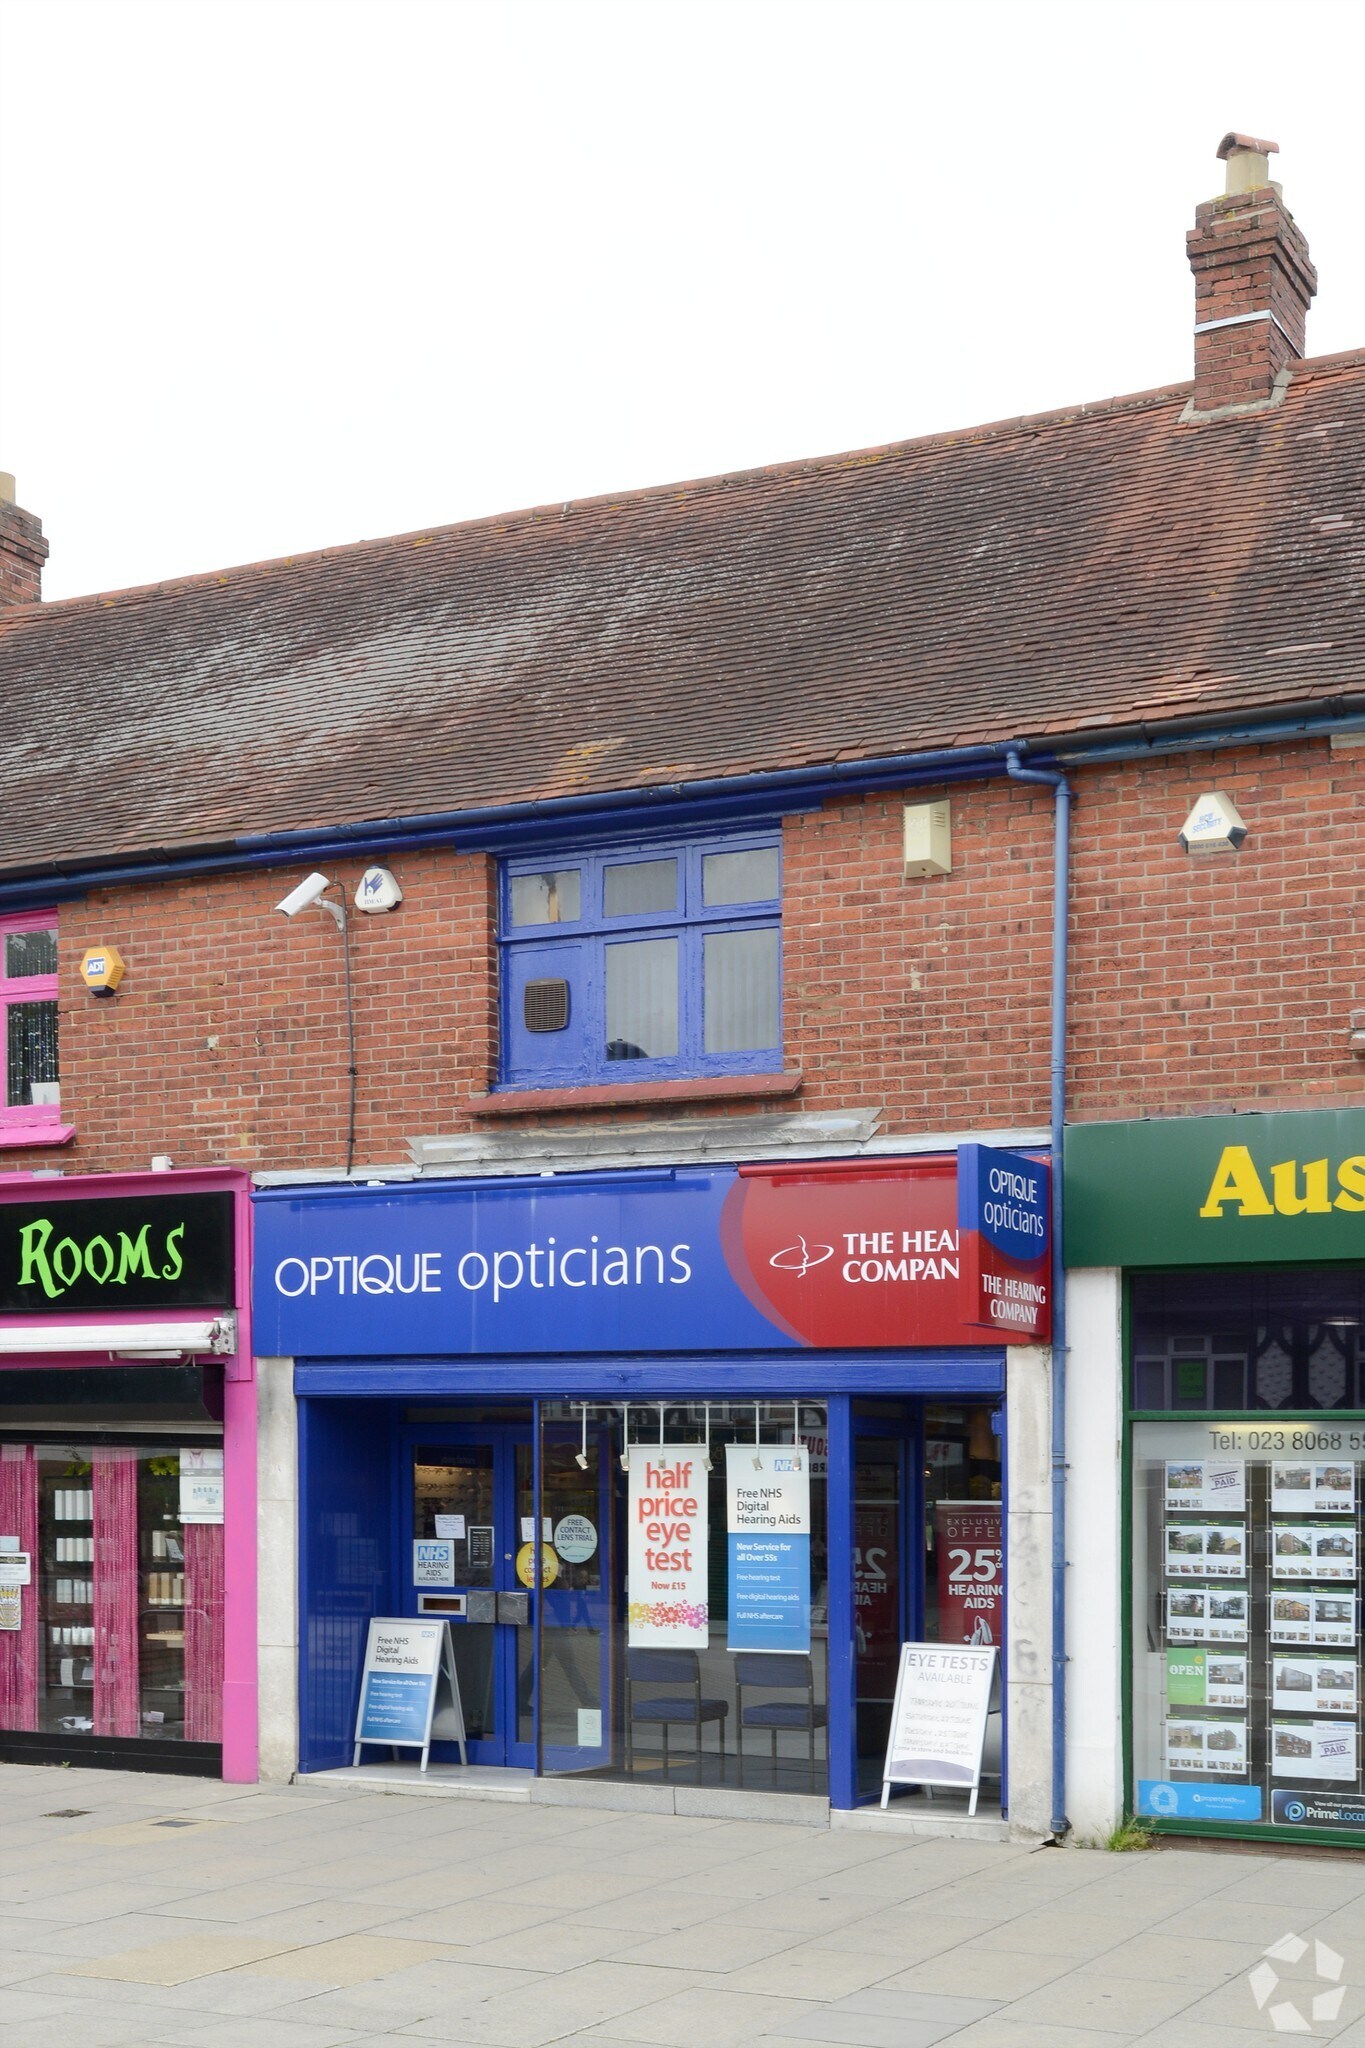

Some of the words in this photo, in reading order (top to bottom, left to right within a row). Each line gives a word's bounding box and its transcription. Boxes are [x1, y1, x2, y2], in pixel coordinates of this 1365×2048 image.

[87, 960, 105, 973] ADT
[989, 1167, 1038, 1204] OPTIQUE
[1200, 1145, 1365, 1218] Aus
[984, 1201, 1044, 1237] opticians
[842, 1231, 894, 1255] THE
[902, 1229, 960, 1253] HEA
[17, 1219, 185, 1299] ROOMS
[274, 1252, 442, 1297] OPTIQUE
[457, 1235, 692, 1303] opticians
[981, 1273, 1002, 1296] THE
[1004, 1278, 1047, 1304] HEARING
[990, 1298, 1039, 1325] COMPANY
[1208, 1431, 1242, 1450] Tel:
[1248, 1431, 1285, 1450] 023
[1292, 1431, 1342, 1450] 8068
[645, 1461, 693, 1489] half
[1214, 1477, 1236, 1487] PAID
[736, 1488, 759, 1498] Free
[760, 1488, 783, 1498] NHS
[638, 1491, 698, 1523] price
[736, 1501, 769, 1514] Digital
[567, 1518, 584, 1526] FREE
[736, 1514, 776, 1527] Hearing
[778, 1514, 802, 1525] Aids
[560, 1526, 591, 1534] CONTACT
[645, 1522, 692, 1549] eye
[418, 1546, 448, 1560] NHS
[736, 1543, 752, 1551] New
[753, 1543, 780, 1551] Service
[780, 1543, 792, 1551] for
[645, 1548, 692, 1572] test
[736, 1553, 745, 1561] all
[764, 1554, 778, 1562] 55s
[417, 1561, 449, 1569] HEARING
[425, 1569, 442, 1577] AIDS
[651, 1581, 670, 1590] Now
[671, 1581, 687, 1591] £15
[963, 1597, 995, 1609] AIDS
[736, 1611, 746, 1619] Full
[377, 1636, 393, 1645] Free
[394, 1637, 409, 1646] NHS
[376, 1645, 400, 1656] Digital
[375, 1655, 402, 1666] Hearing
[403, 1656, 419, 1665] Aids
[907, 1653, 937, 1668] EYE
[940, 1655, 989, 1672] TESTS
[1169, 1664, 1204, 1676] OPEN
[918, 1671, 973, 1685] AVAILABLE
[1323, 1745, 1346, 1755] PAID
